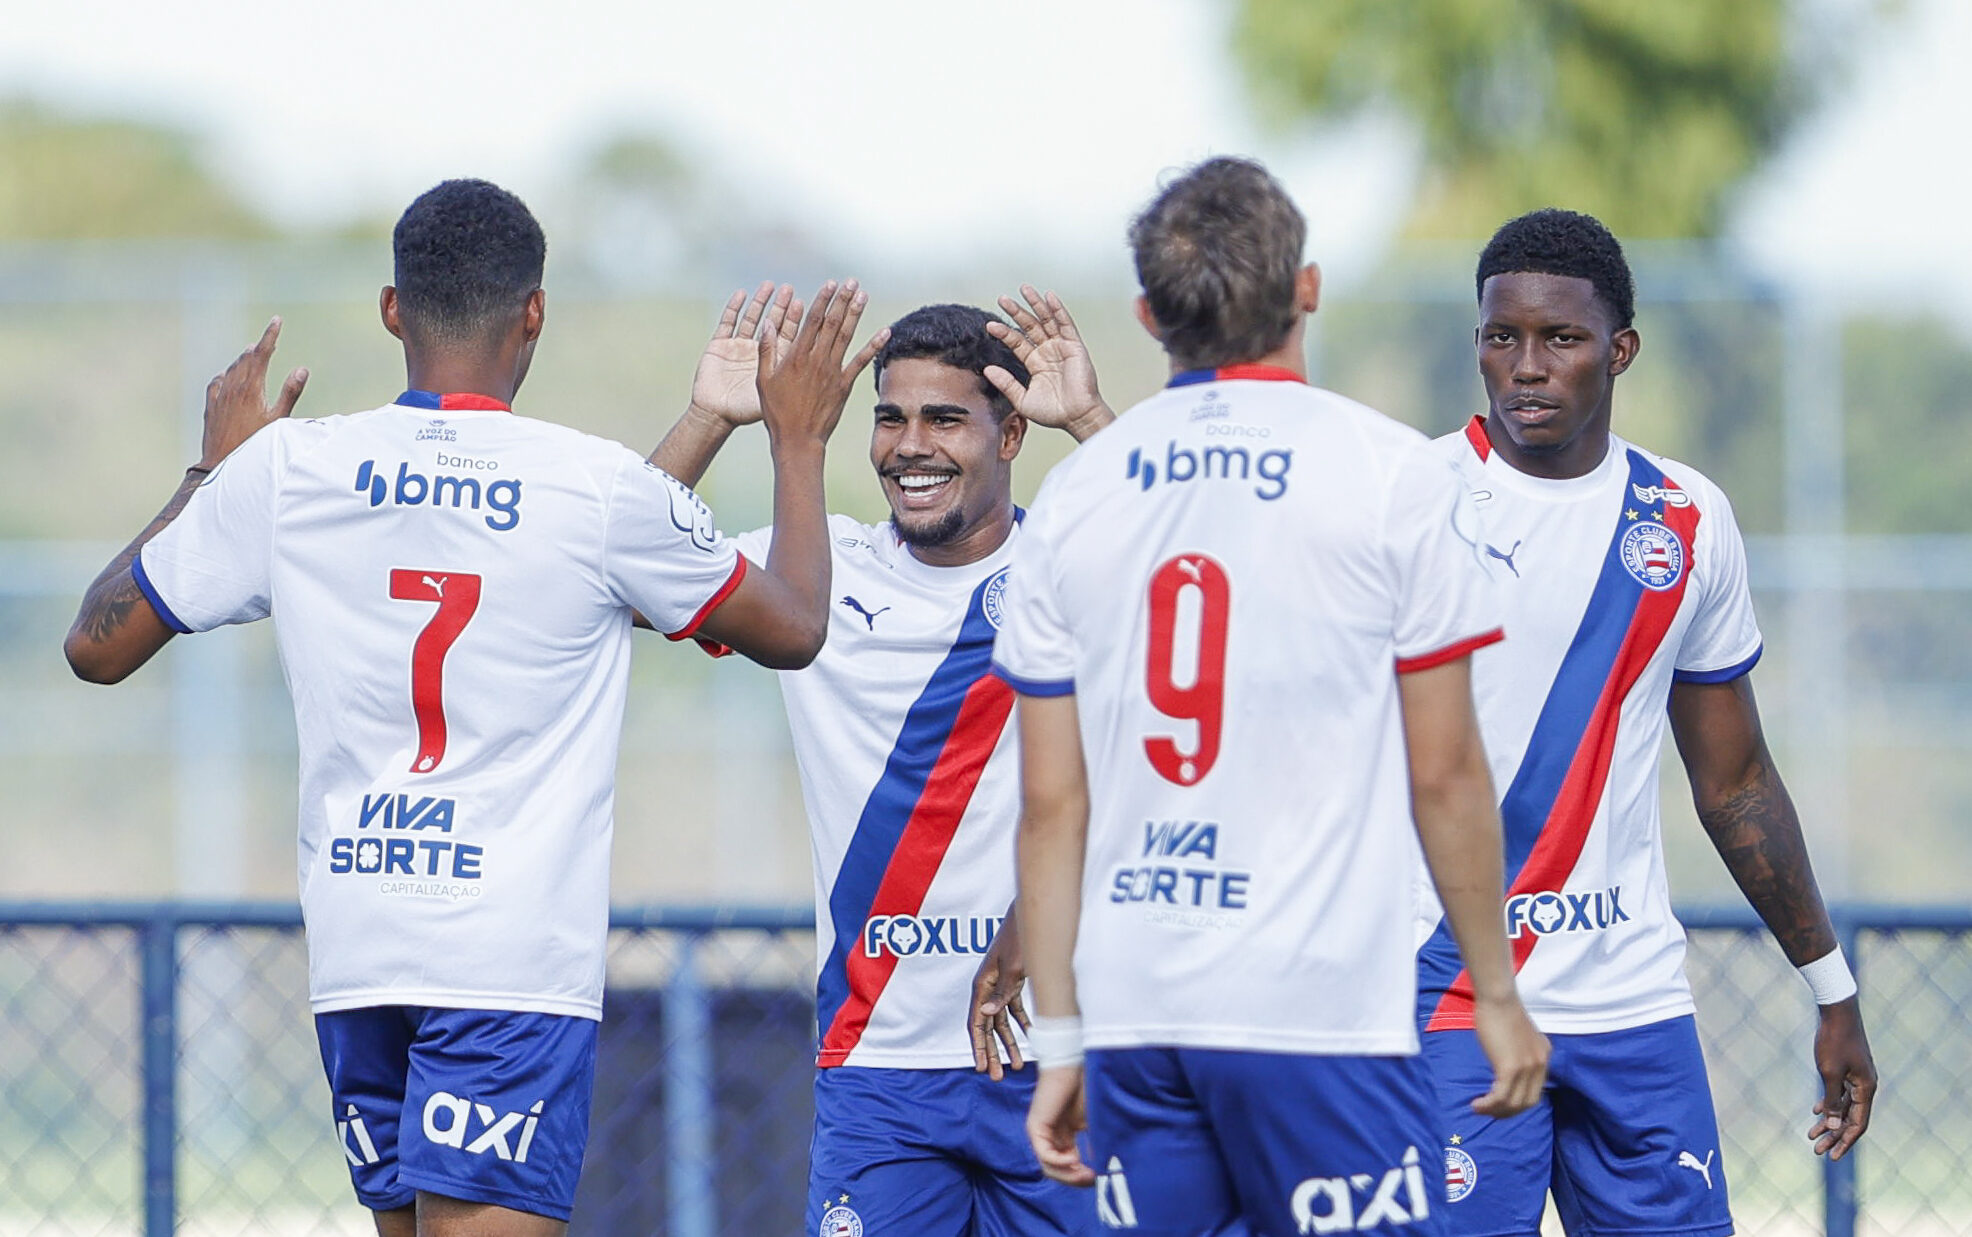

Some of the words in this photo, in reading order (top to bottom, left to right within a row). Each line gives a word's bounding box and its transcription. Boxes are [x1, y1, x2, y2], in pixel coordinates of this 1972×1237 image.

[444, 428, 457, 436] DO
[437, 451, 499, 471] banco
[1166, 441, 1293, 501] bmg
[395, 461, 521, 531] bmg
[1624, 530, 1641, 573] ESPORTE
[1640, 526, 1673, 541] CLUBE
[1669, 541, 1680, 571] BAHIA
[389, 568, 482, 774] 7
[1143, 552, 1231, 788] 9
[358, 793, 455, 833] VIVA
[329, 837, 484, 879] SORTE
[380, 882, 481, 899] CAPITALIZAÇÃO
[1110, 867, 1251, 909] SORTE
[422, 1091, 545, 1164] axi
[1290, 1144, 1430, 1235] axi
